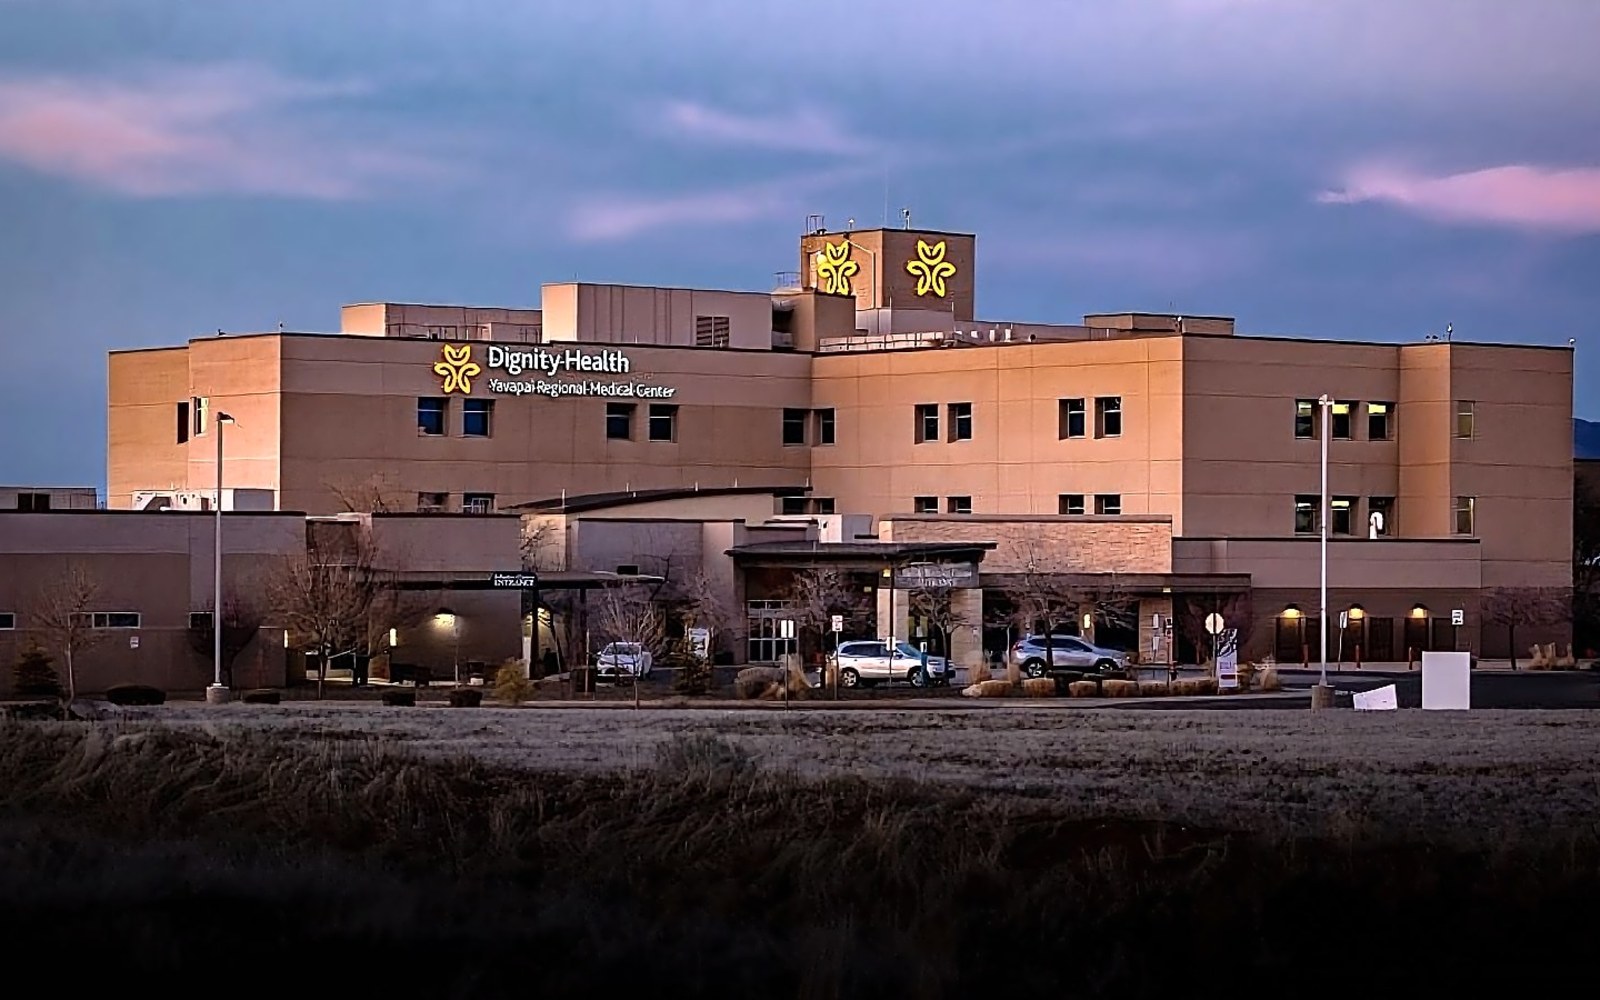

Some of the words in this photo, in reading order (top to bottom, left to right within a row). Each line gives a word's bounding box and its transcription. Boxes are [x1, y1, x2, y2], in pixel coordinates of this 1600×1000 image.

[488, 346, 561, 376] Dignity
[565, 349, 630, 373] Health
[489, 379, 535, 396] Yavapai
[537, 380, 587, 398] Regional
[590, 381, 634, 396] Medical
[636, 384, 675, 398] Center
